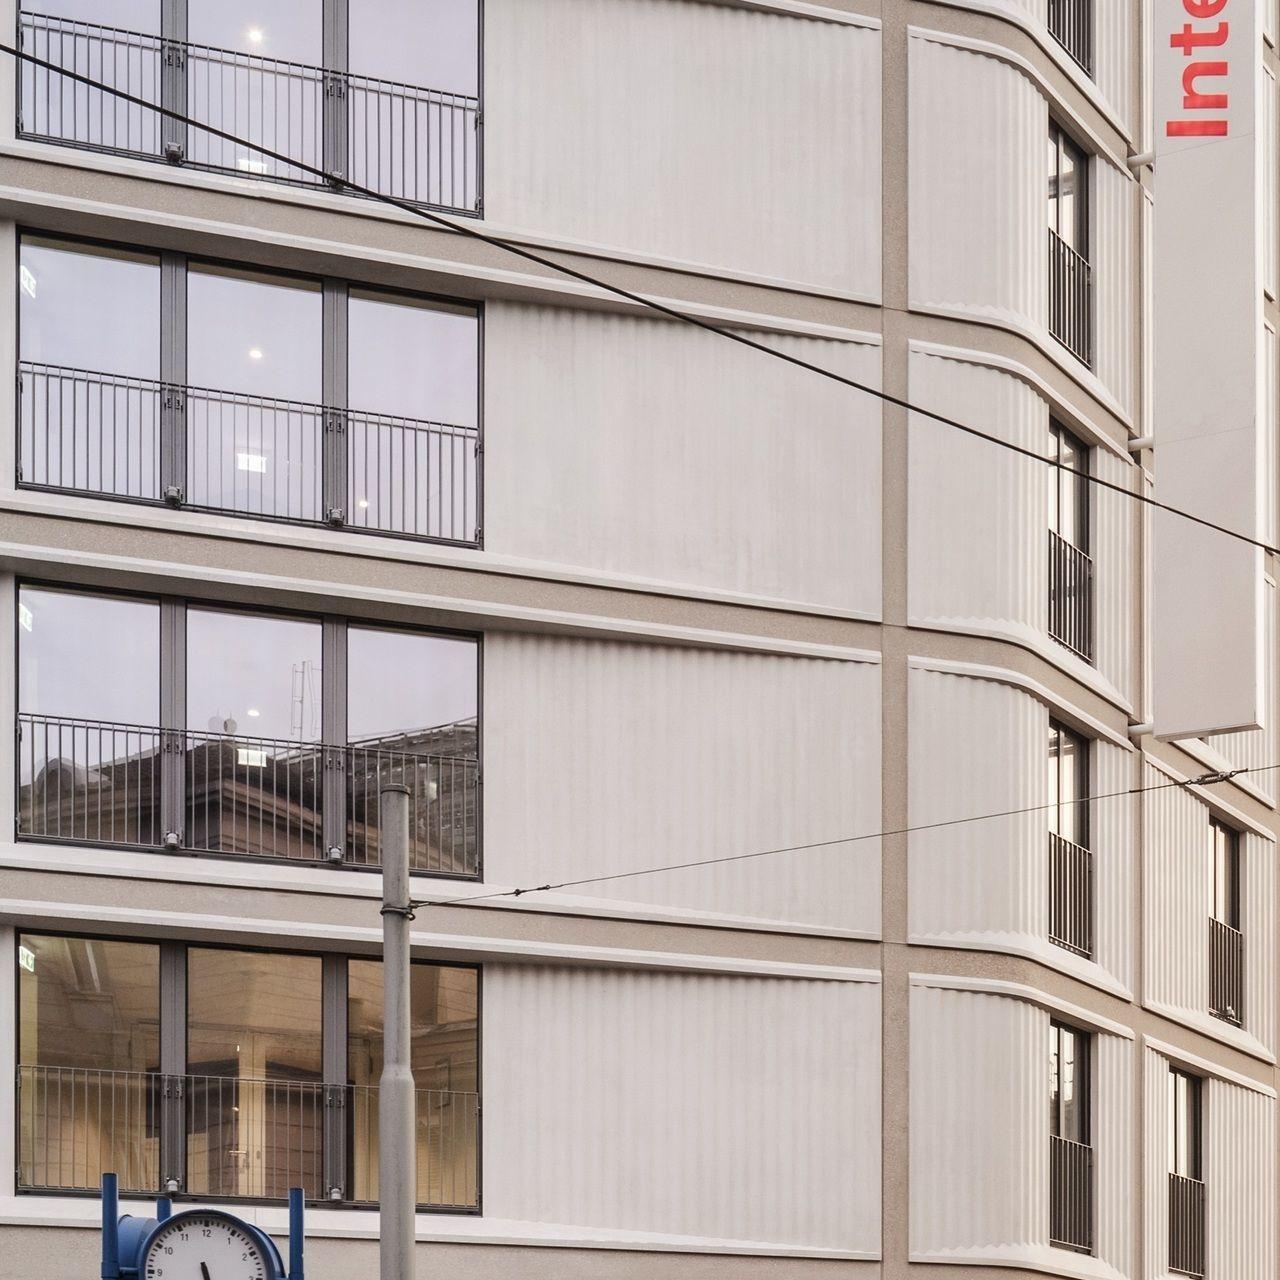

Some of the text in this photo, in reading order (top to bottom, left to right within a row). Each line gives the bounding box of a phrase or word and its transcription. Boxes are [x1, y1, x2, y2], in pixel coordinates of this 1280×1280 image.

[202, 1229, 212, 1237] 12
[227, 1237, 231, 1245] 1
[164, 1246, 173, 1255] 10
[242, 1253, 248, 1261] 2
[157, 1269, 163, 1277] 9
